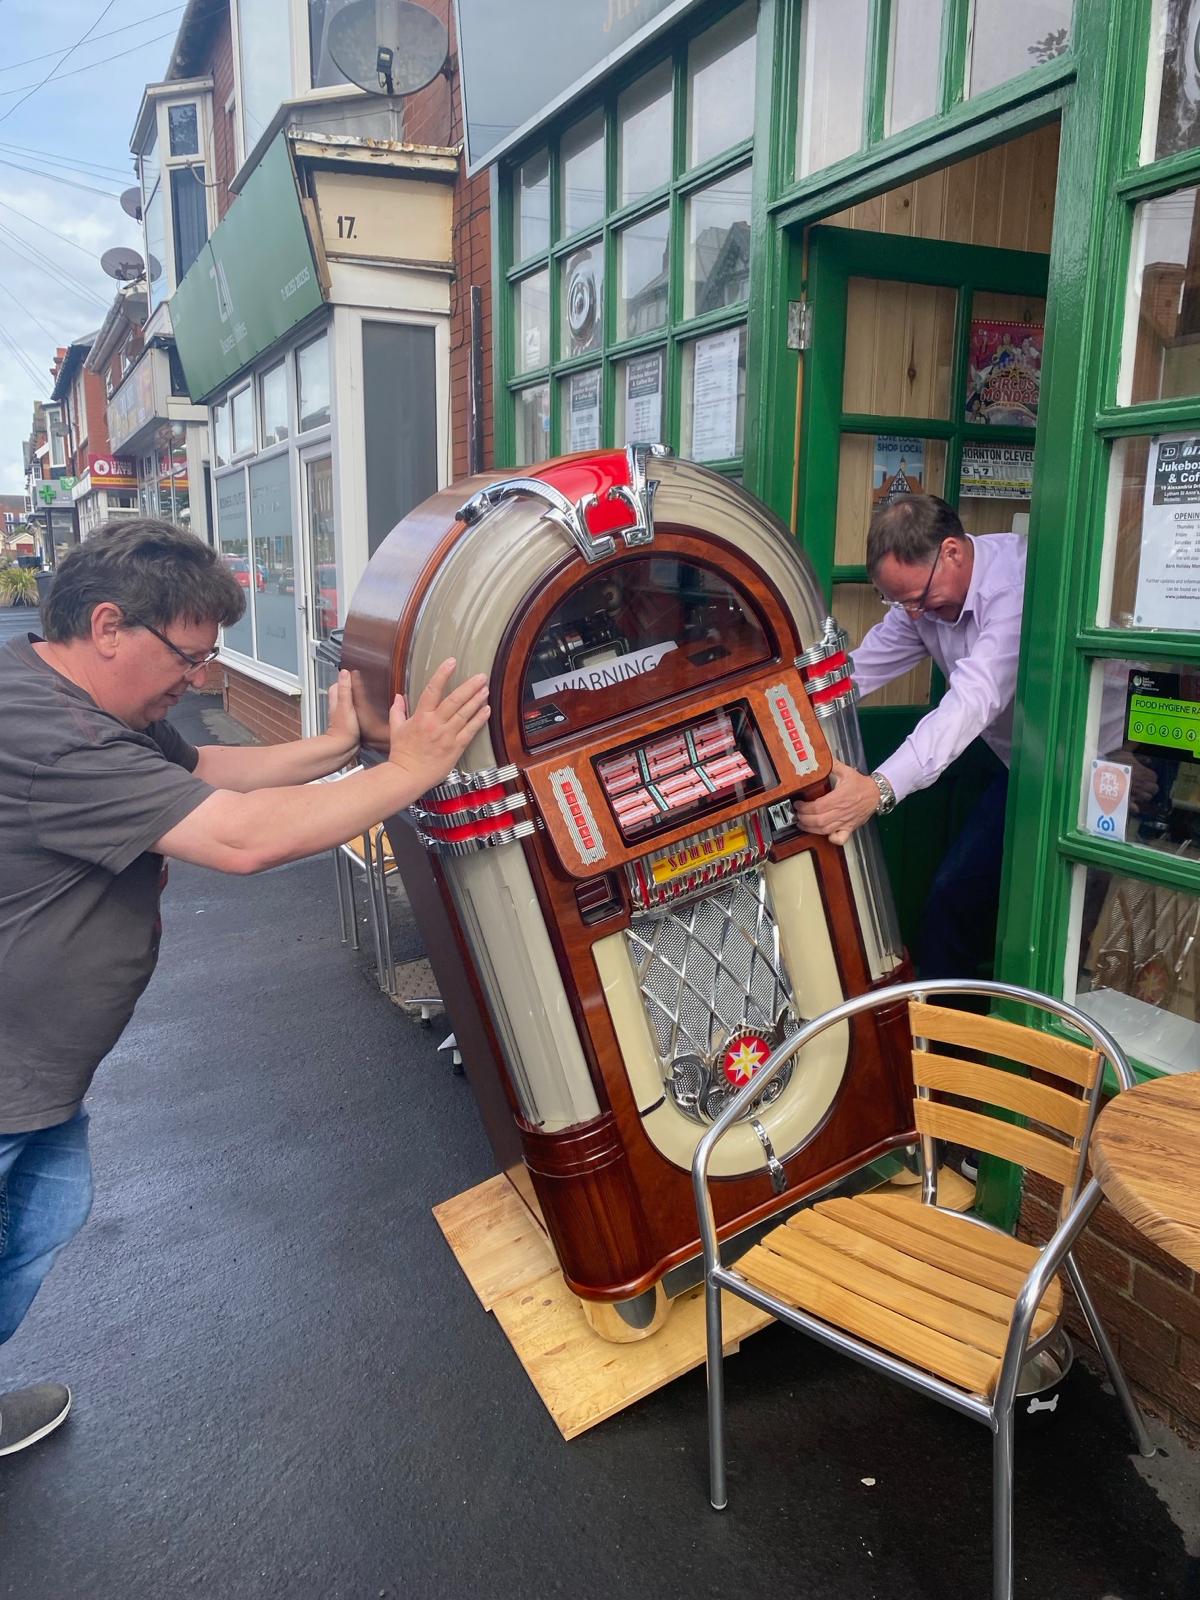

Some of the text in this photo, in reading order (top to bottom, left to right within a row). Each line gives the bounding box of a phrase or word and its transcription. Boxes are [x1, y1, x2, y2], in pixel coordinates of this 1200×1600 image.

[336, 215, 358, 239] 17.
[988, 377, 1035, 390] CIRCUS
[877, 443, 922, 454] SHOP LOCAL
[962, 448, 1002, 461] HORNTON
[1158, 461, 1200, 473] Jukebo
[1168, 474, 1177, 484] &
[1174, 512, 1200, 520] OPENIN
[554, 655, 658, 692] WARNING
[1136, 700, 1158, 709] FOOD
[1158, 703, 1191, 714] HYGIENE
